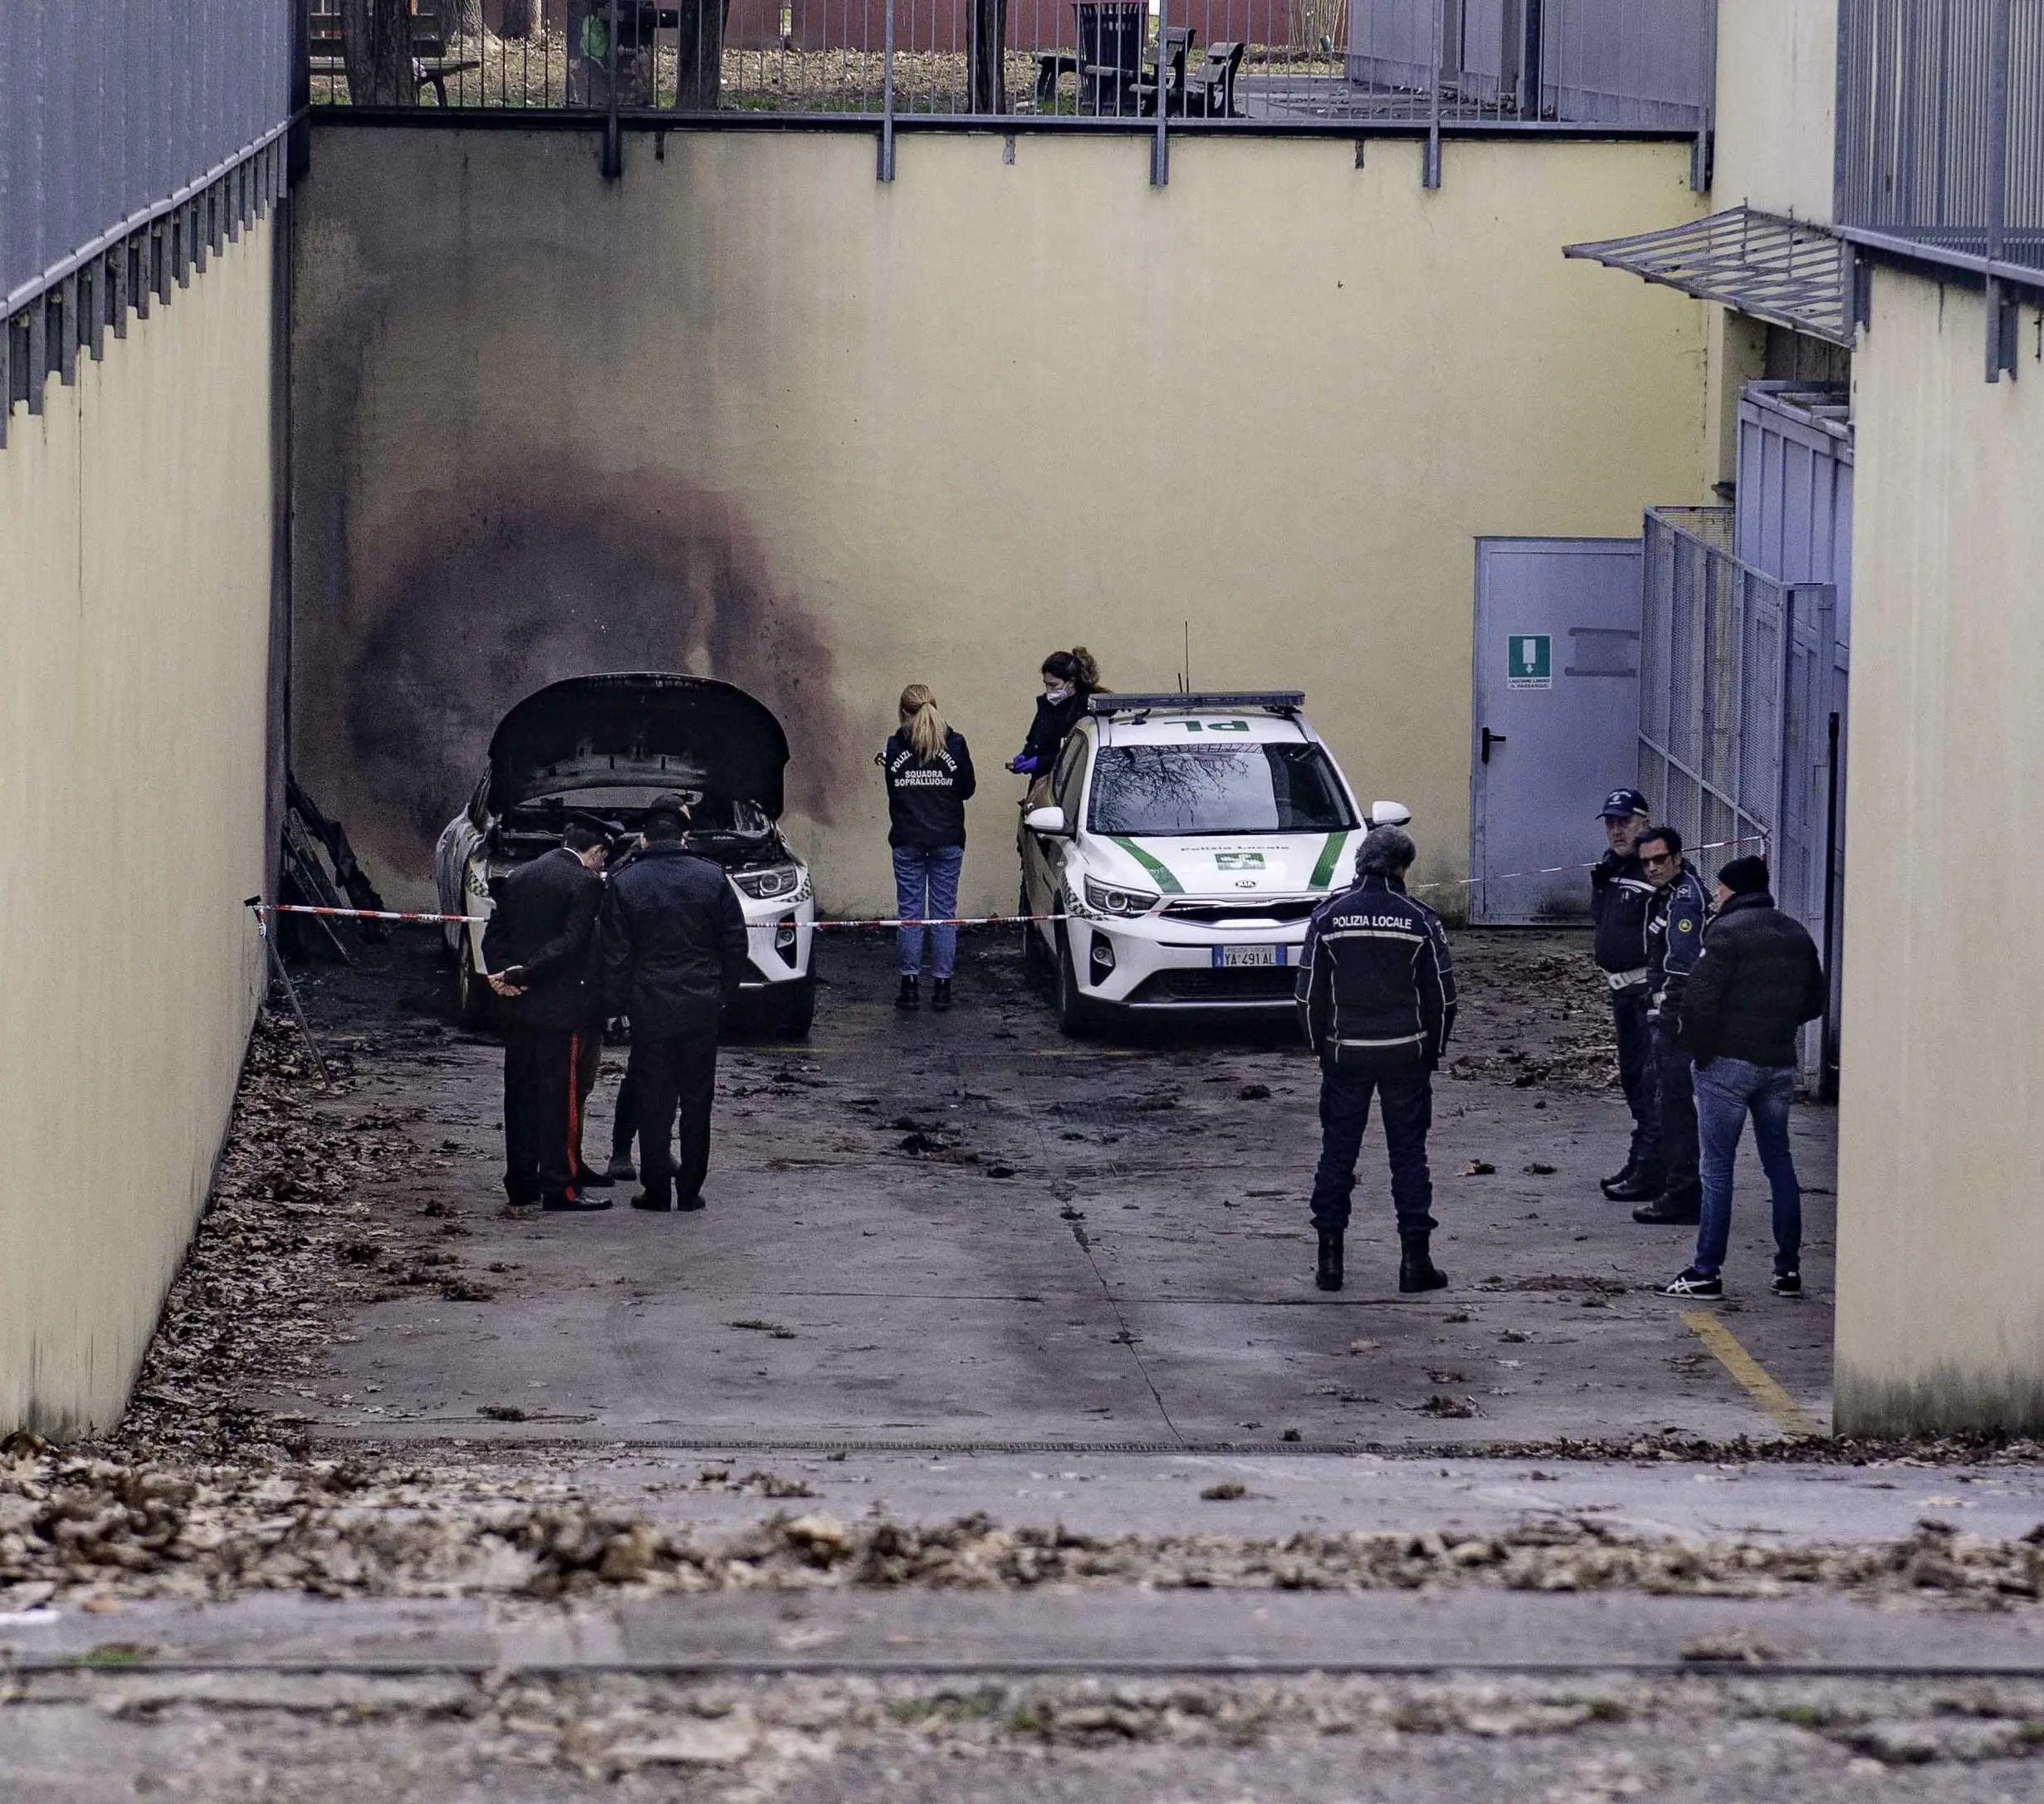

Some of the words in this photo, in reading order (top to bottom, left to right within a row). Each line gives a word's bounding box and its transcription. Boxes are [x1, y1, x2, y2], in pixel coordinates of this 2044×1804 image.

[1163, 721, 1249, 731] PL
[890, 750, 912, 772] POLIZI
[937, 749, 957, 772] TIFICA
[904, 770, 943, 779] SQUADRA
[894, 778, 953, 787] SOPRALLUOGHI
[1333, 915, 1370, 927] POLIZIA
[1372, 916, 1412, 929] LOCALE
